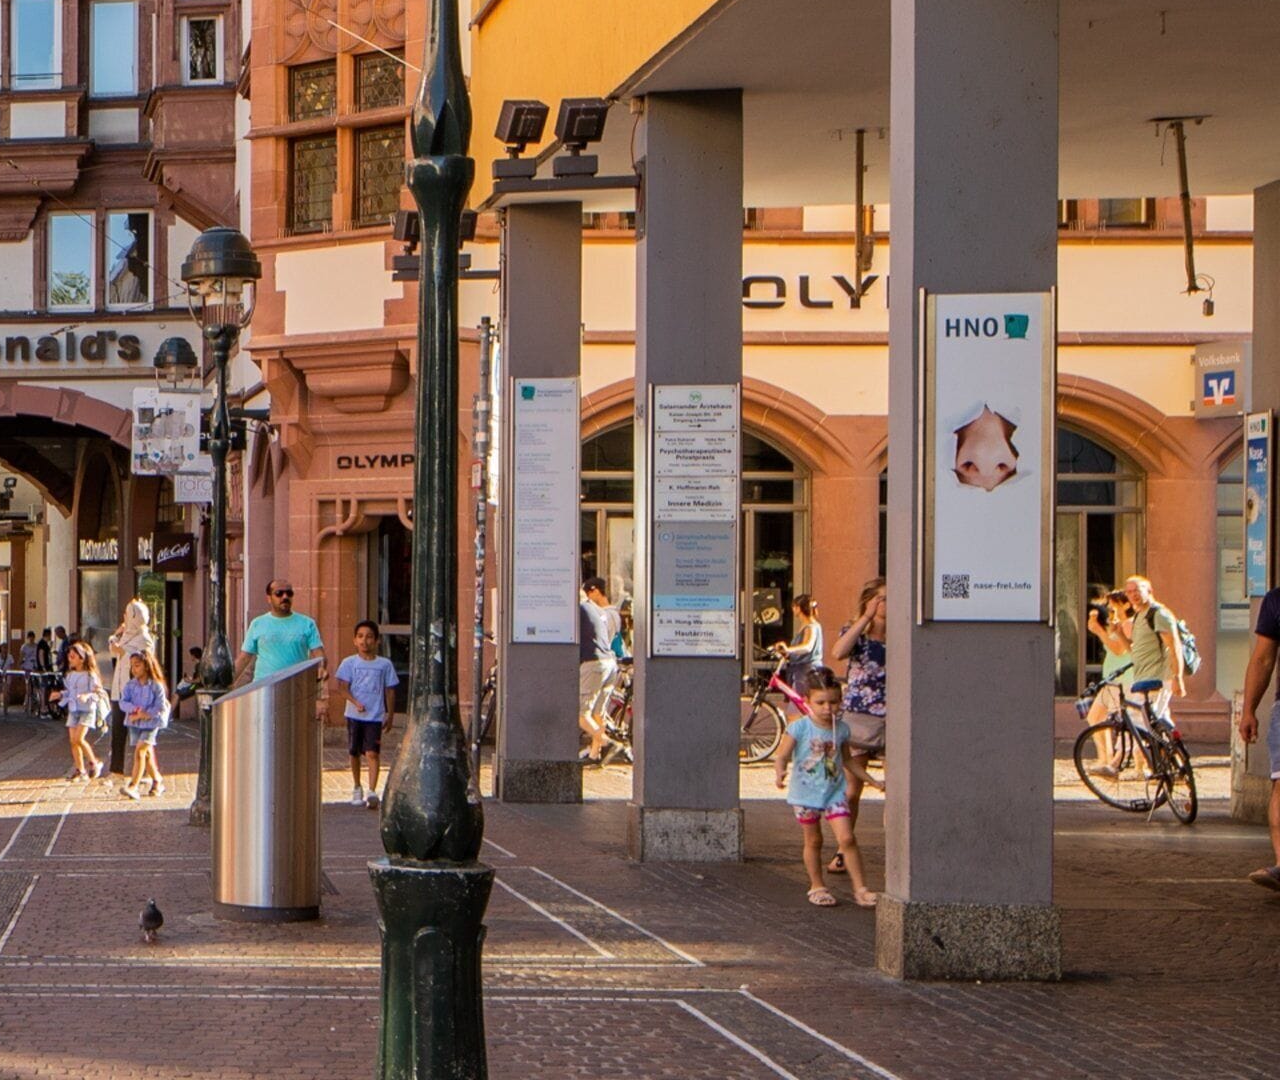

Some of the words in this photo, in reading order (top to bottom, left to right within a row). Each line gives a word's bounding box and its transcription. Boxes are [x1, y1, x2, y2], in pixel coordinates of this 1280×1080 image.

[742, 275, 890, 309] OLY
[945, 317, 999, 337] HNO
[1198, 352, 1241, 368] Volksbank
[337, 453, 416, 469] OLYMP
[973, 582, 1032, 590] nase-frei.info
